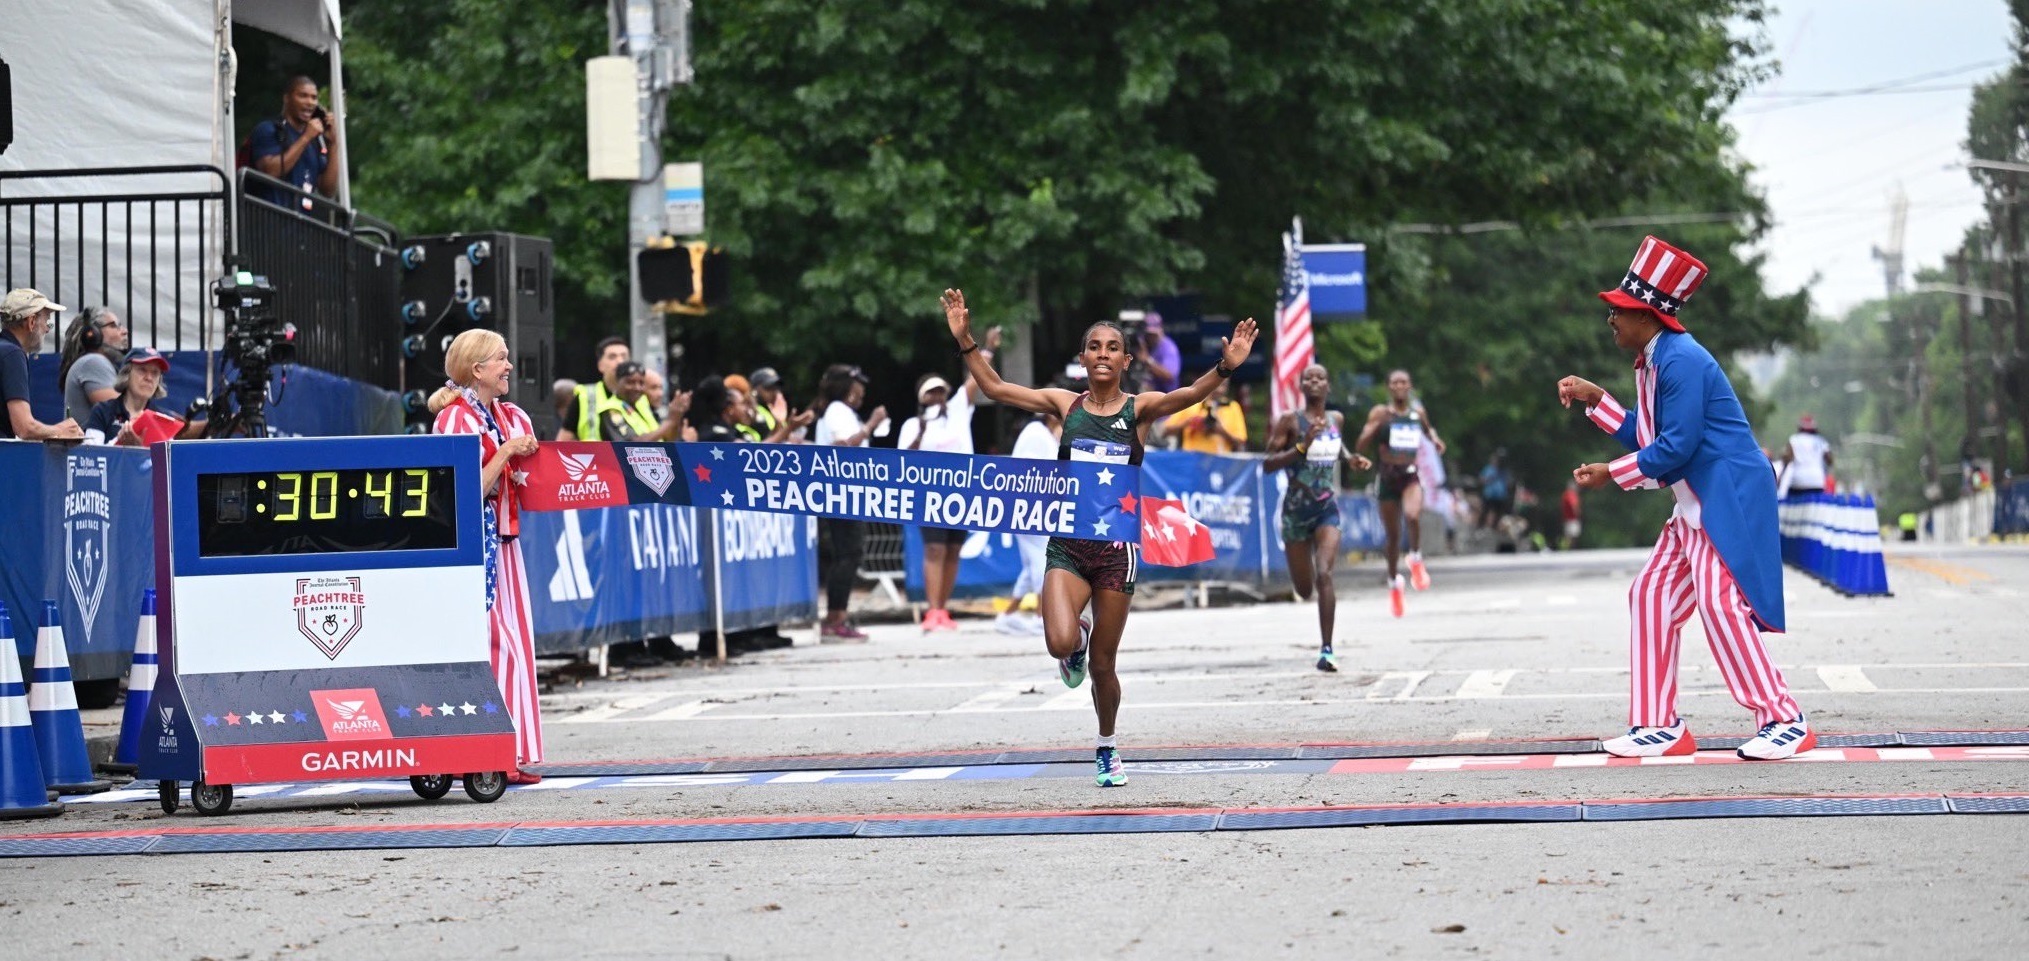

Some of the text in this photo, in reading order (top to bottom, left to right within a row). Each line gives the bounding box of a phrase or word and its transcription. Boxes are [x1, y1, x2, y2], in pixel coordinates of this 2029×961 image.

[628, 456, 670, 464] PEACHTREE
[738, 448, 1080, 496] 2023 Atlanta Journal-Constitution
[558, 481, 610, 496] ATLANTA
[558, 492, 611, 502] TRACK CLUB
[65, 491, 109, 519] PEACHTREE
[745, 478, 1076, 534] PEACHTREE ROAD RACE
[293, 592, 365, 607] PEACHTREE
[332, 720, 381, 731] ATLANTA
[158, 736, 178, 748] ATLANTA
[301, 748, 416, 772] GARMIN
